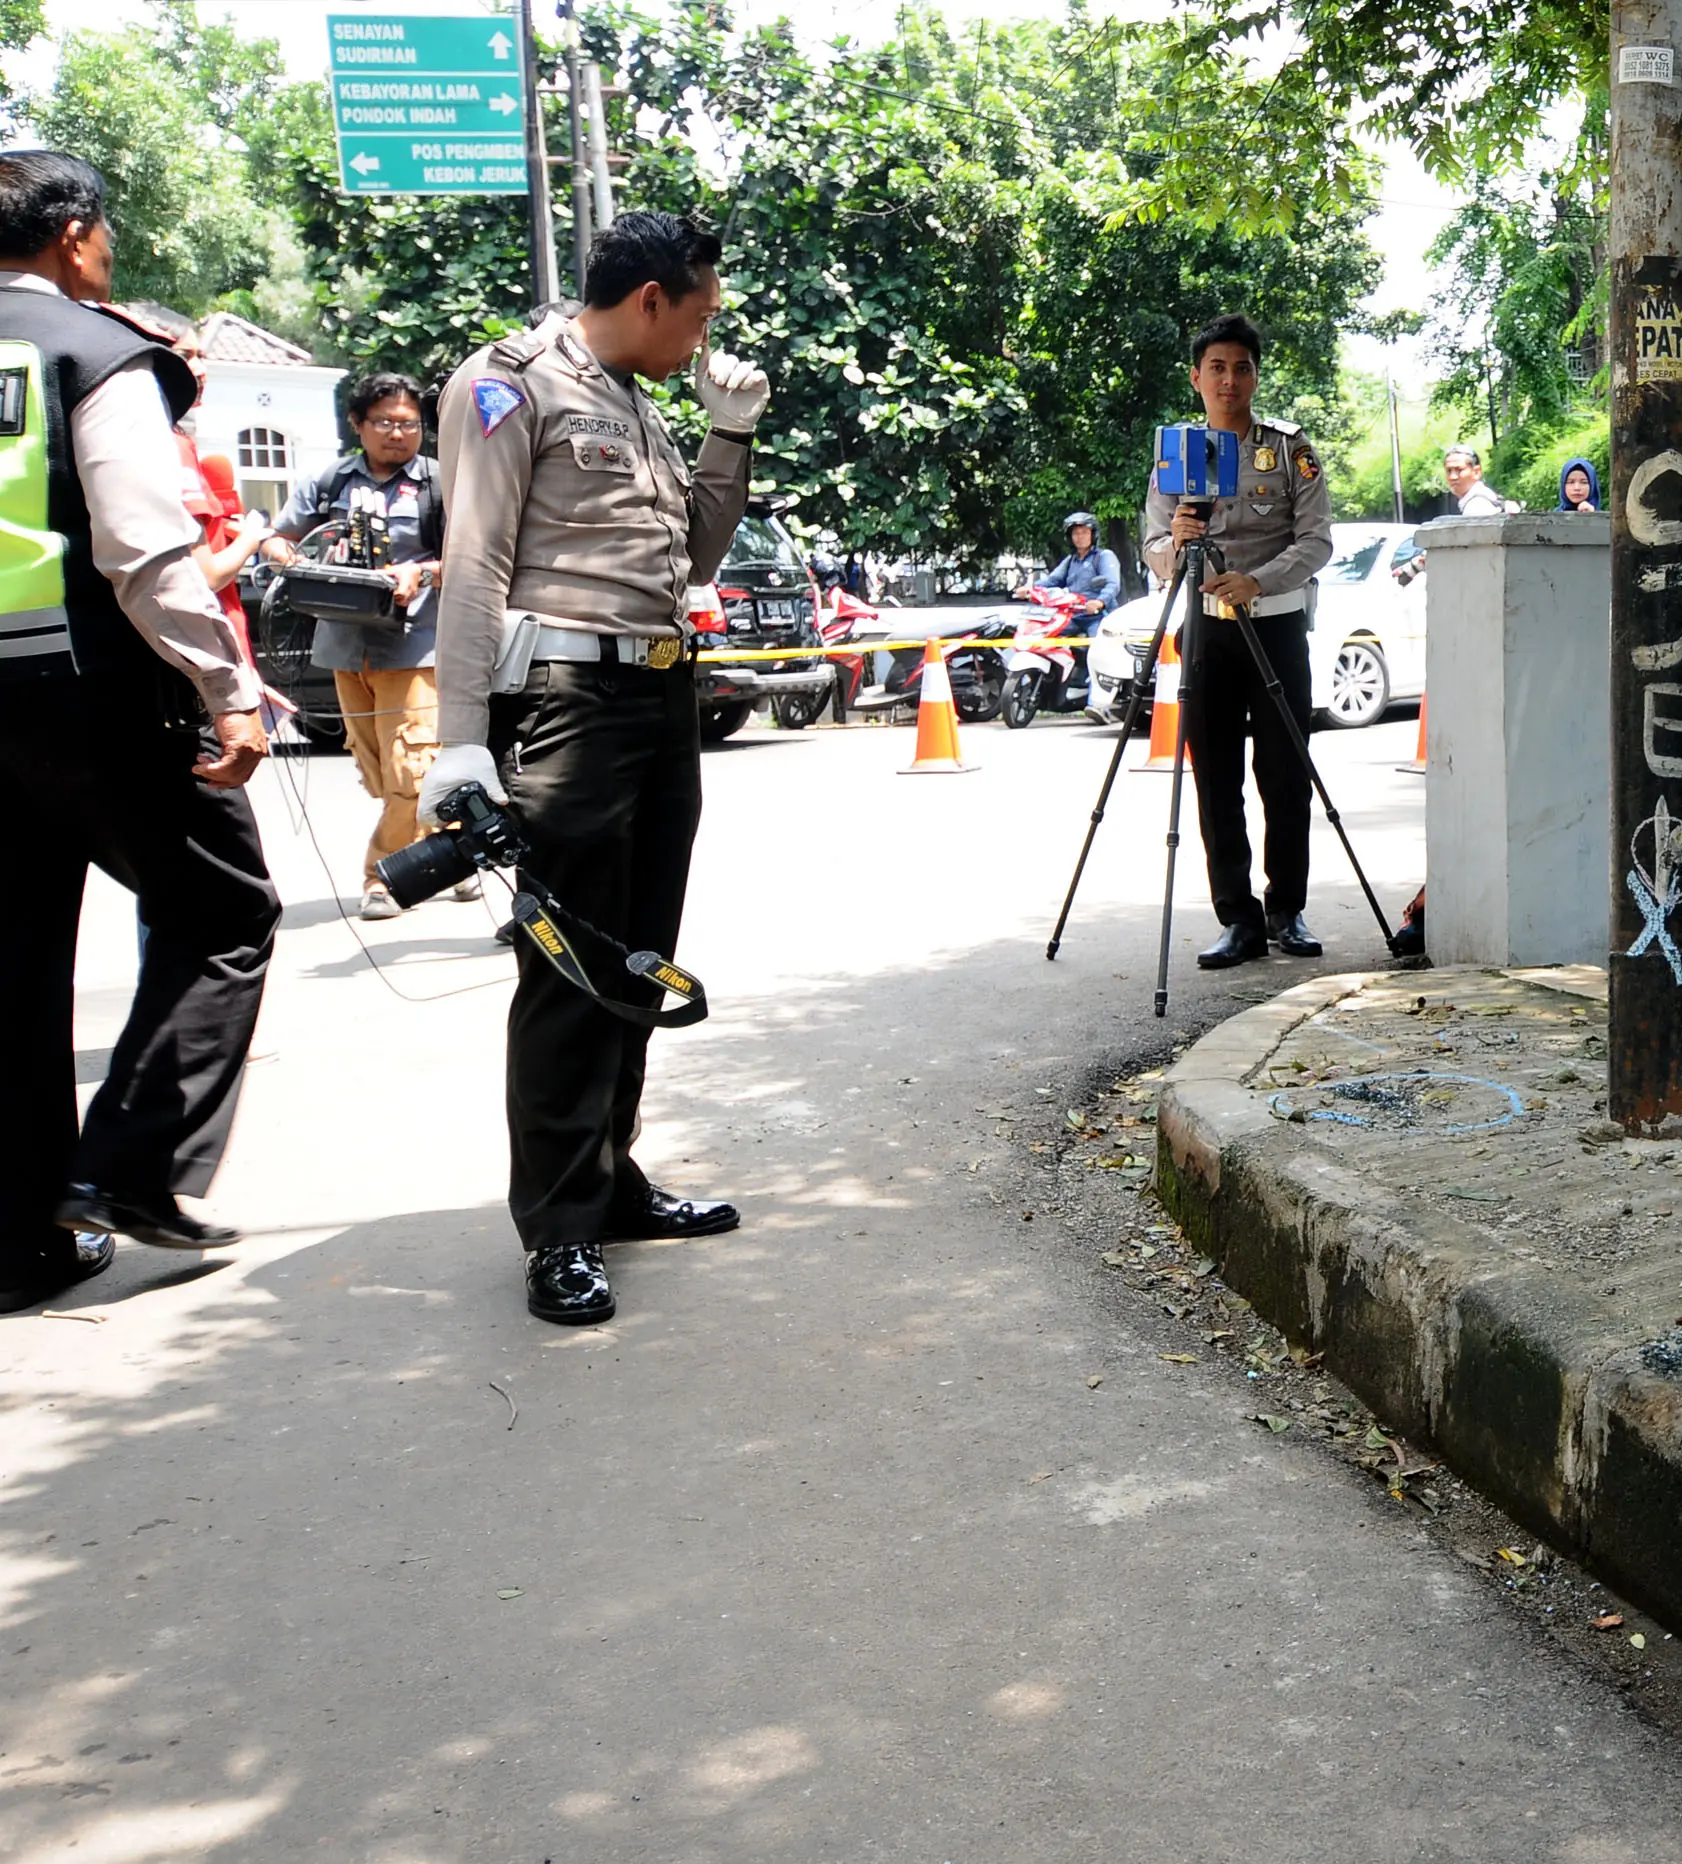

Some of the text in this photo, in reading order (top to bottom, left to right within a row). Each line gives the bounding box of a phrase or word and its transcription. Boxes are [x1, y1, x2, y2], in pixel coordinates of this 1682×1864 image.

[333, 24, 404, 40] SENAYAN
[336, 46, 416, 63] SUDIRMAN
[1645, 52, 1668, 61] WC
[339, 83, 480, 100] KEBAYORAN LAMA
[341, 107, 457, 123] PONDOK INDAH
[411, 143, 442, 160] POS
[423, 166, 527, 183] KEBON JERUK
[1636, 298, 1677, 320] ANA
[1636, 325, 1682, 358] PAT
[532, 919, 564, 956] Nikon
[655, 966, 692, 994] Nikon
